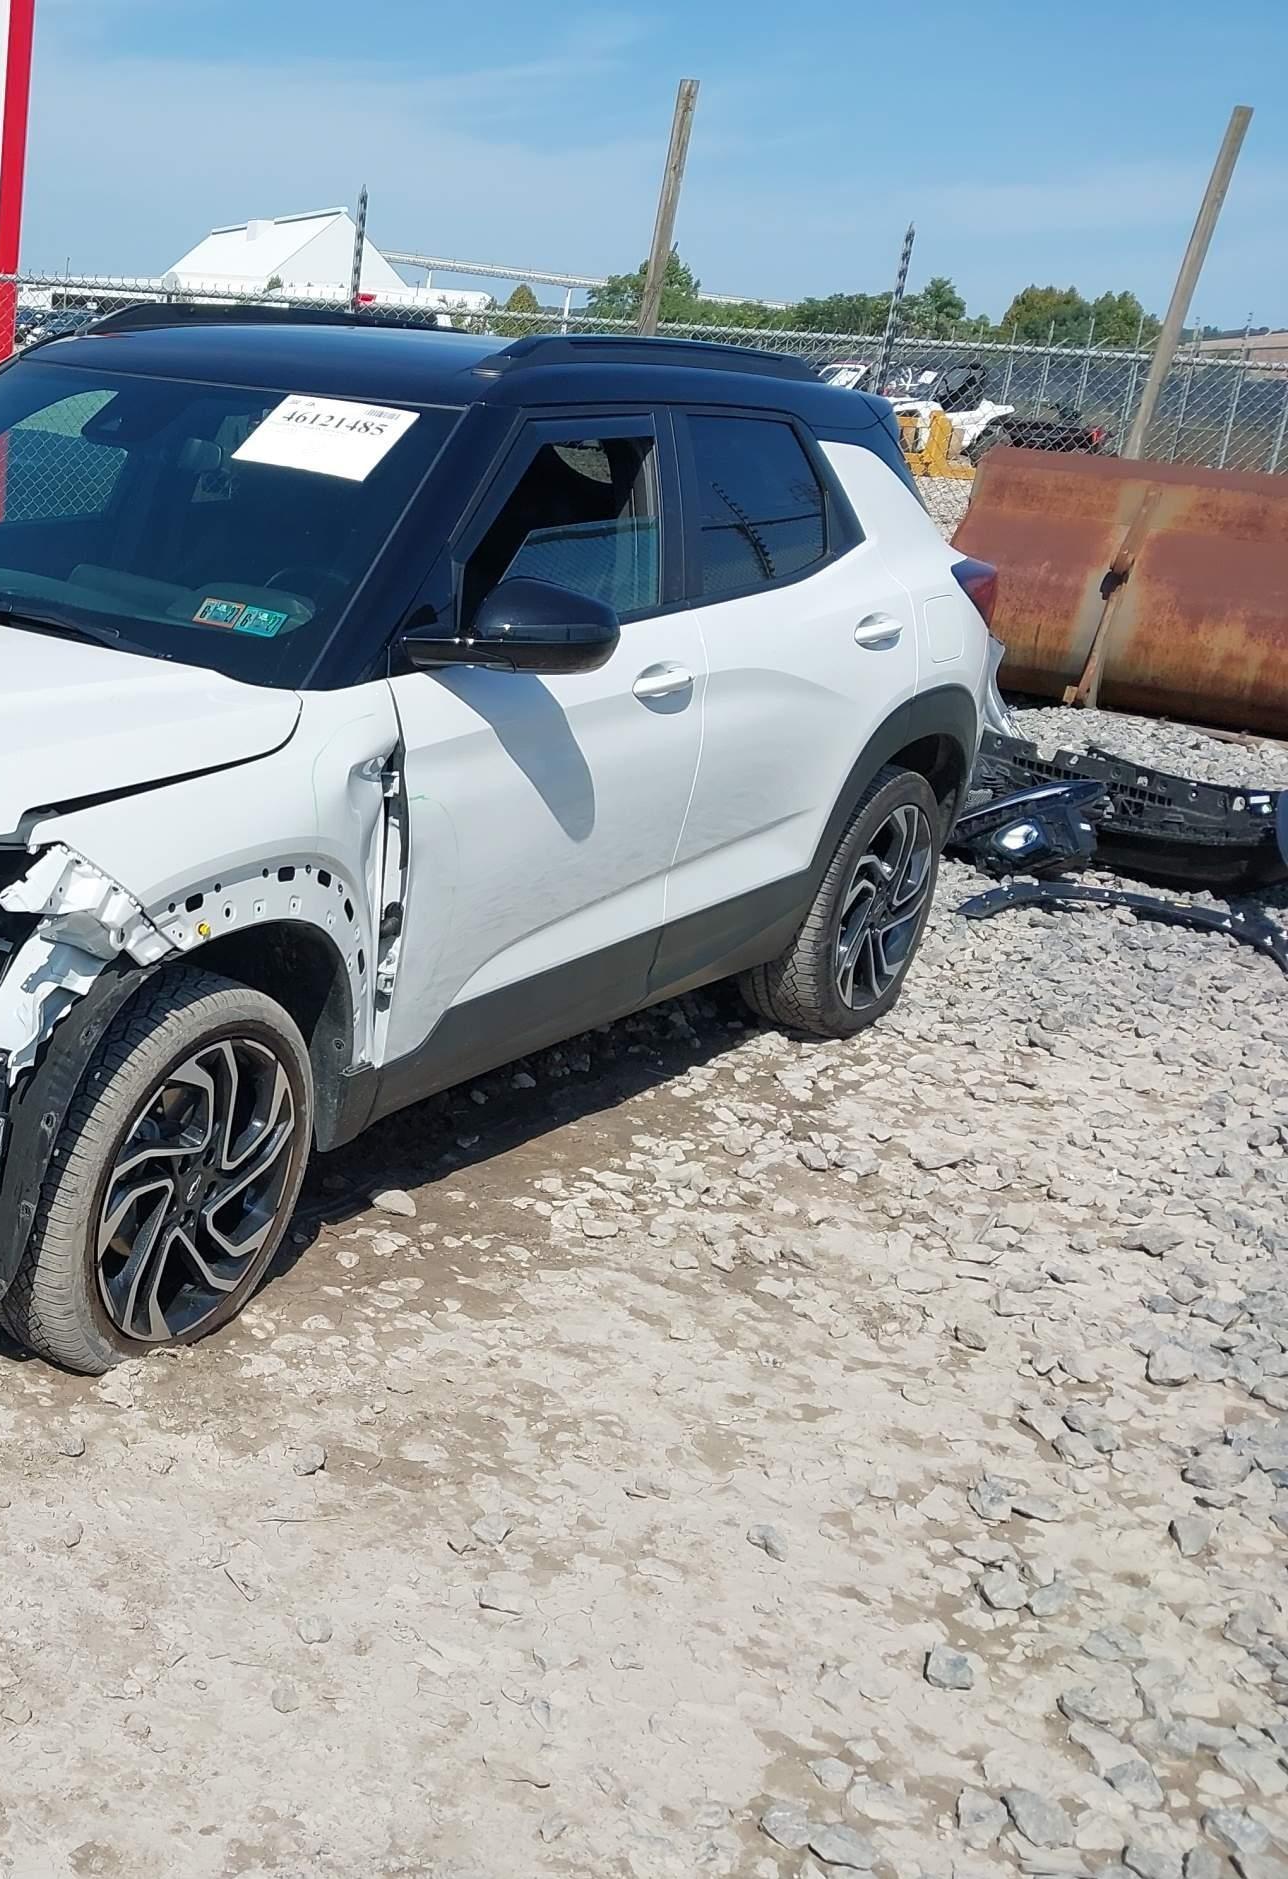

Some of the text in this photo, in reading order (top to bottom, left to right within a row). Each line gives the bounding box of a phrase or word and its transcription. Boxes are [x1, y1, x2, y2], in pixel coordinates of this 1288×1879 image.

[282, 410, 389, 436] 46121485
[199, 605, 211, 618] 6
[240, 613, 251, 626] 6
